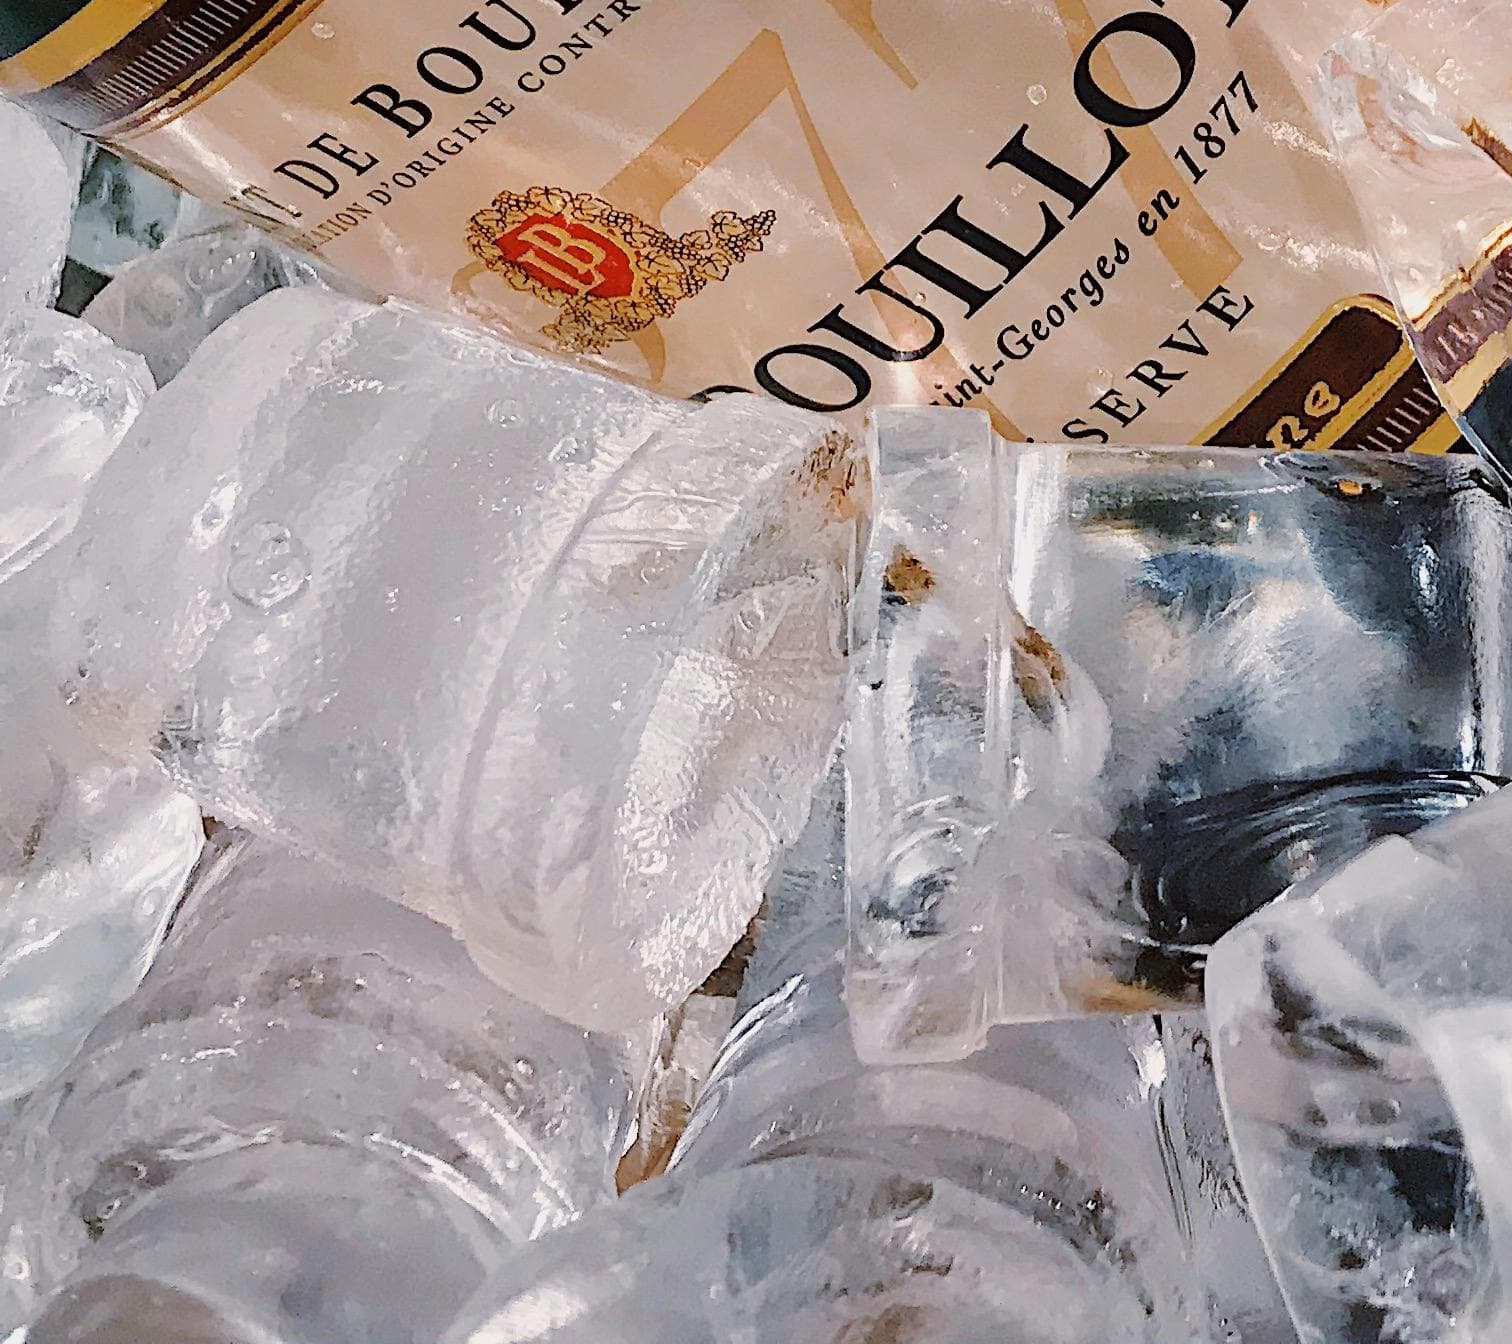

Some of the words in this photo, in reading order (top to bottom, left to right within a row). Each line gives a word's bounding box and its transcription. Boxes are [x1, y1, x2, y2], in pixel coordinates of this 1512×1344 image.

[273, 132, 380, 201] DE
[365, 93, 515, 207] D'ORIGINE
[928, 236, 1131, 408] int-Georges
[1136, 187, 1181, 238] en
[1173, 69, 1261, 186] 1877
[1026, 283, 1256, 445] SERVE
